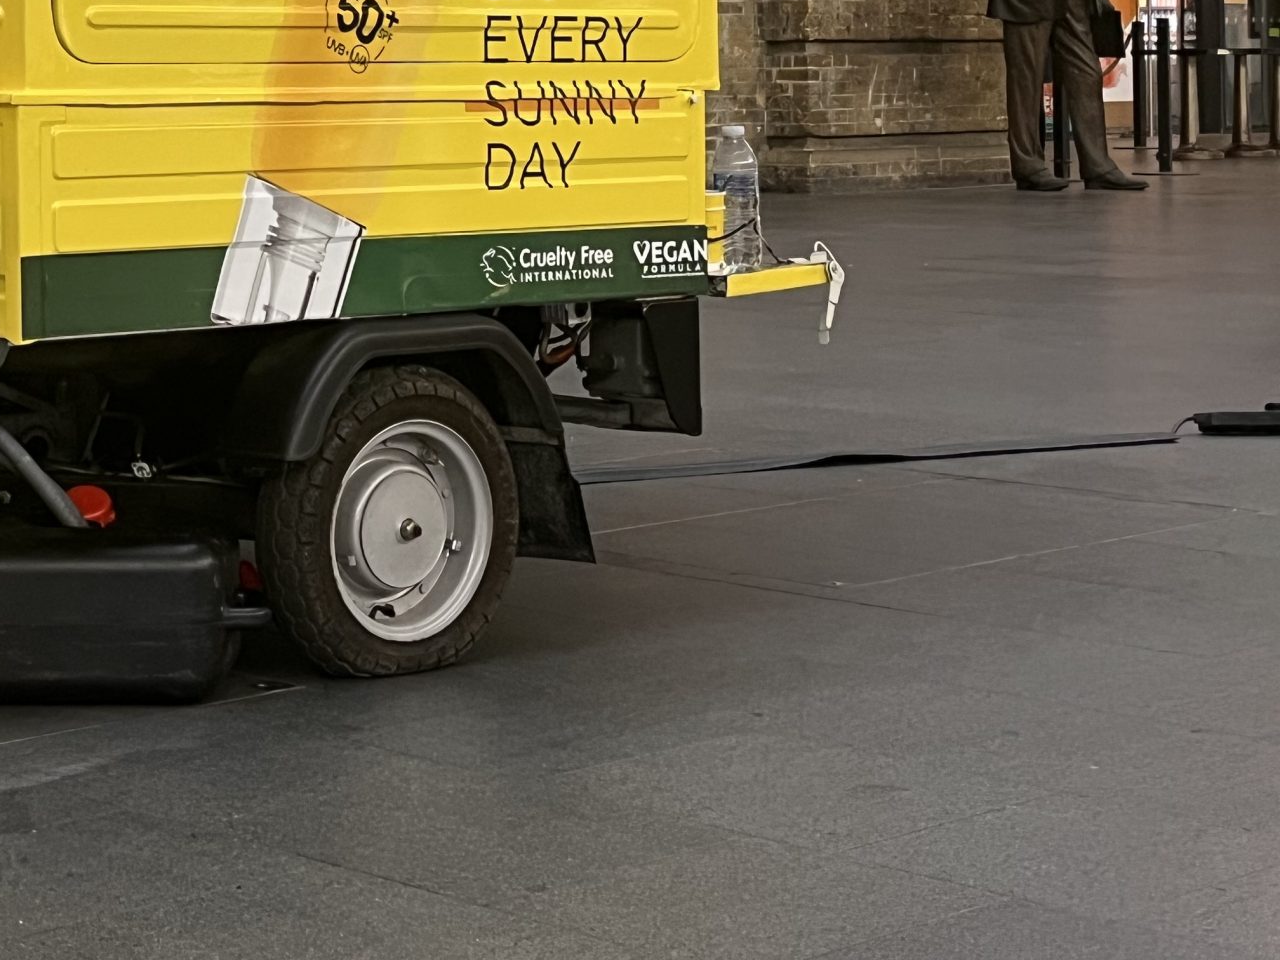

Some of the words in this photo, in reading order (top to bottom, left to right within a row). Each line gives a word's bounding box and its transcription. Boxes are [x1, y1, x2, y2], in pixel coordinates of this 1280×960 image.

[483, 15, 644, 64] EVERY
[483, 79, 647, 127] SUNNY
[484, 140, 582, 191] DAY
[519, 245, 577, 270] Cruelty
[580, 245, 614, 265] Free
[632, 238, 708, 264] VEGAN
[519, 267, 615, 283] INTERNATIONAL
[642, 262, 704, 274] FORMULA
